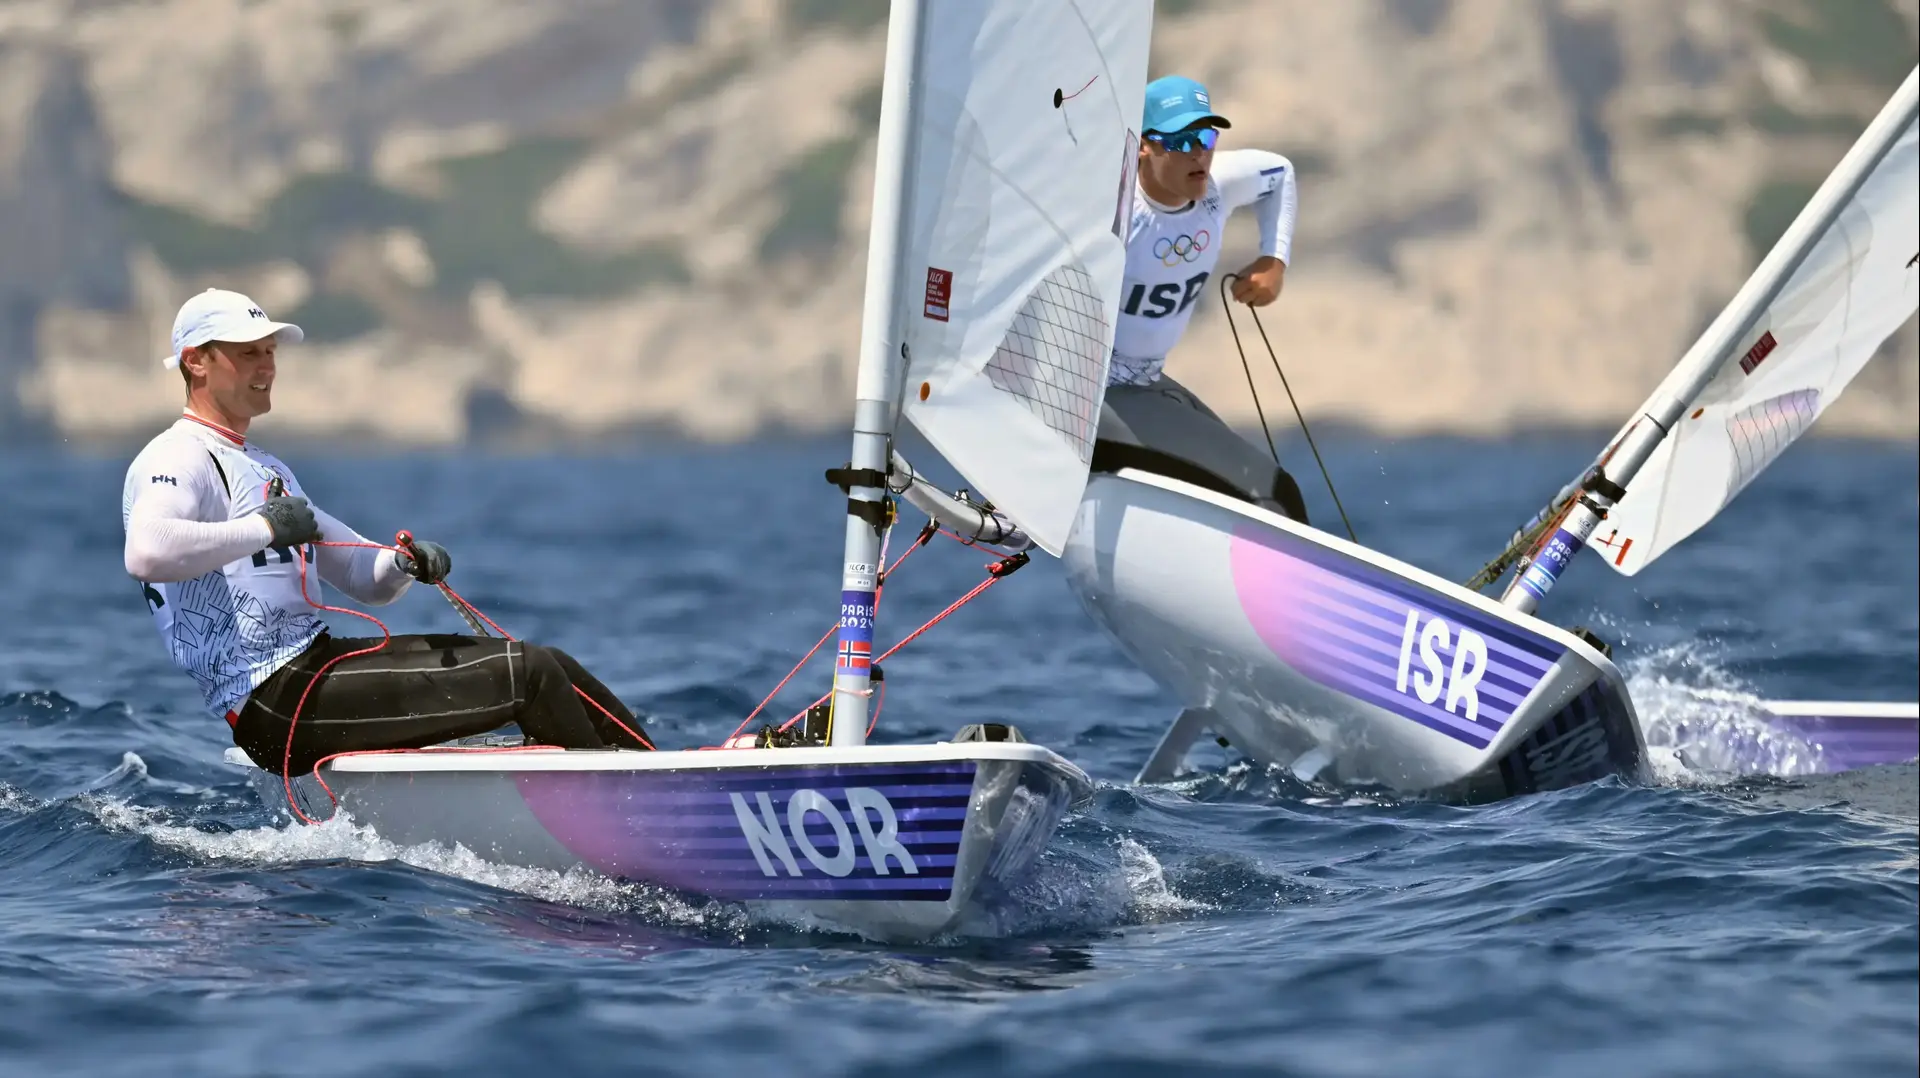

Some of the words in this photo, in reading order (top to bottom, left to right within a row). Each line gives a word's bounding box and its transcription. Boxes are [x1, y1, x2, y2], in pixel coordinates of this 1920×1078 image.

[151, 474, 177, 487] HH
[1543, 546, 1567, 568] 202
[841, 604, 874, 617] PARIS
[1396, 609, 1488, 722] ISR
[729, 787, 919, 877] NOR
